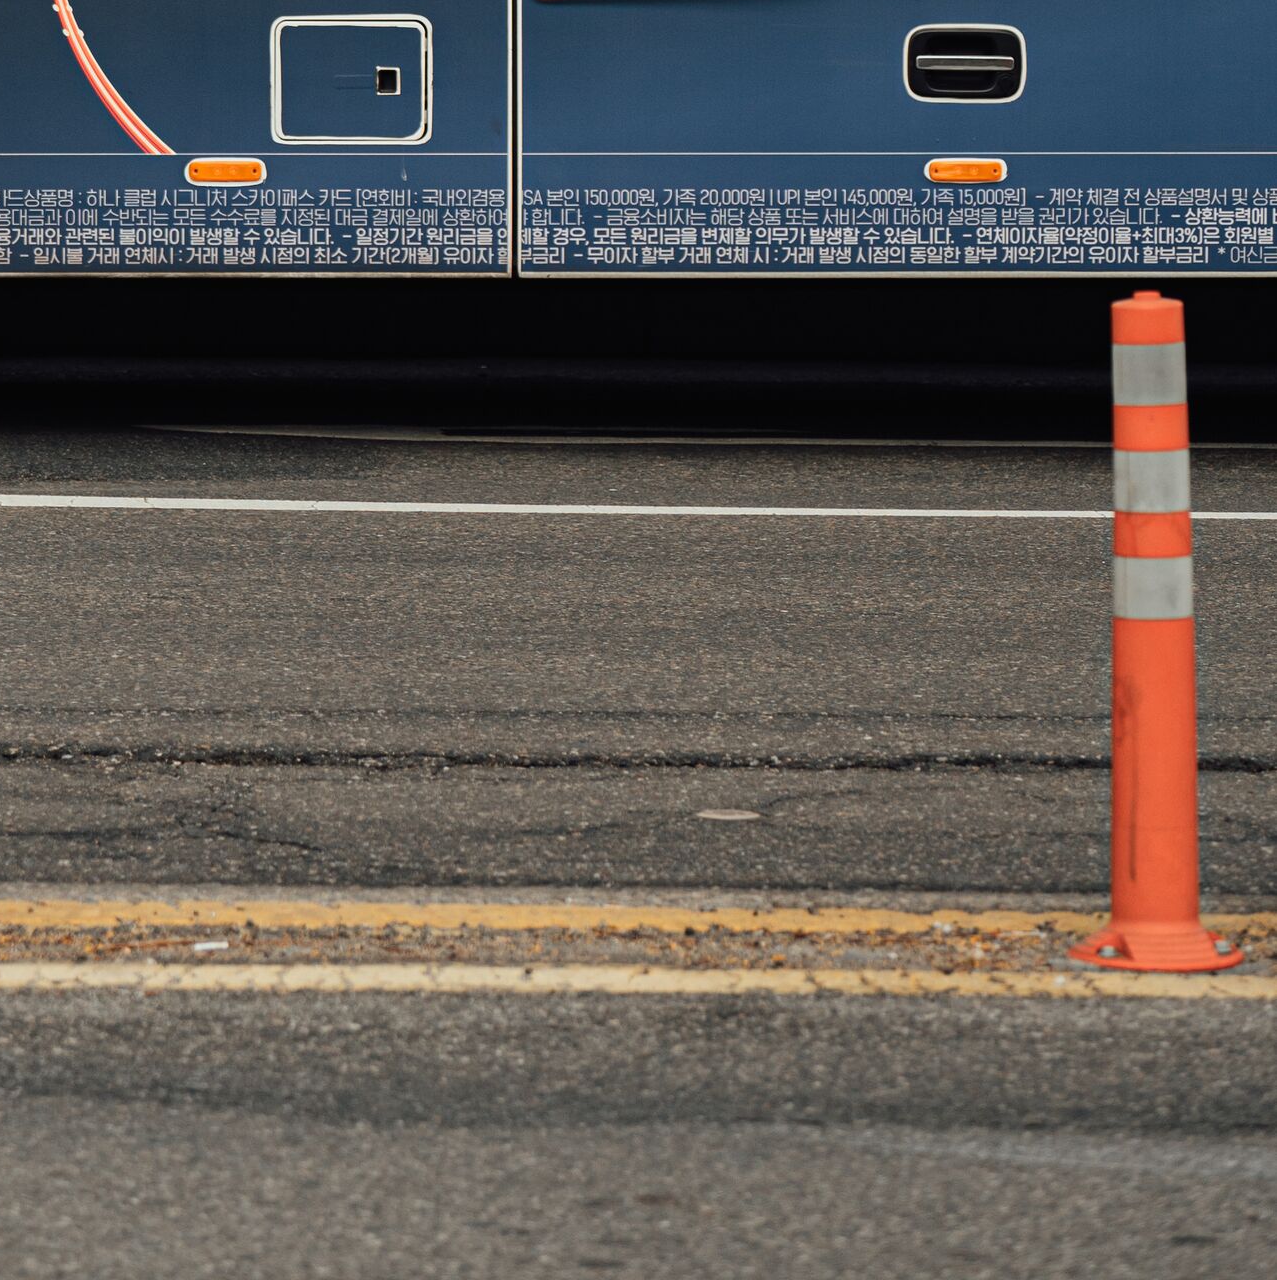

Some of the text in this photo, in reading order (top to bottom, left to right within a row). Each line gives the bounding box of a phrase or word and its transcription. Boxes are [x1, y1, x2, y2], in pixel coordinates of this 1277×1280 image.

[87, 189, 120, 207] 하나
[124, 189, 157, 207] 클럽
[161, 189, 227, 207] 시그니처
[231, 189, 315, 207] 스카이패스
[319, 189, 352, 207] 카드
[356, 189, 410, 207] [연회비
[422, 189, 505, 207] 국내외겸용
[547, 189, 579, 207] 본인
[584, 189, 658, 208] 150,000원,
[663, 188, 696, 206] 가족
[699, 188, 765, 206] 20,000원
[805, 188, 837, 206] 본인
[841, 188, 917, 207] 145,000원,
[921, 188, 955, 206] 가족
[959, 188, 1025, 206] 15,000원]
[1049, 188, 1083, 206] 계약
[1087, 188, 1119, 206] 체결
[1123, 188, 1139, 206] 전
[1144, 188, 1227, 206] 상품설명서
[1232, 188, 1247, 206] 및
[66, 209, 97, 226] 이에
[103, 209, 169, 226] 수반되는
[173, 209, 207, 226] 모든
[211, 209, 277, 226] 수수료를
[281, 209, 330, 226] 지정된
[335, 209, 369, 226] 대금
[373, 209, 438, 226] 결제일에
[532, 209, 585, 226] 합니다.
[607, 209, 707, 226] 금융소비자는
[711, 208, 744, 225] 해당
[748, 208, 781, 225] 상품
[785, 208, 818, 225] 또는
[823, 208, 888, 225] 서비스에
[894, 208, 942, 225] 대하여
[948, 208, 997, 225] 설명을
[1001, 208, 1034, 225] 받을
[1039, 208, 1089, 225] 권리가
[1093, 208, 1162, 225] 있습니다.
[1185, 208, 1267, 225] 상환능력에
[65, 228, 114, 245] 관련된
[119, 228, 185, 245] 불이익이
[190, 228, 240, 245] 발생할
[243, 228, 260, 245] 수
[264, 228, 335, 245] 있습니다.
[356, 228, 423, 245] 일정기간
[427, 228, 493, 245] 원리금을
[553, 228, 589, 246] 경우,
[593, 228, 627, 245] 모든
[631, 227, 697, 244] 원리금을
[701, 227, 752, 244] 변제할
[755, 227, 805, 244] 의무가
[810, 227, 859, 244] 발생할
[863, 227, 880, 244] 수
[884, 227, 954, 244] 있습니다.
[1224, 227, 1273, 244] 회원별
[33, 247, 83, 265] 일시불
[87, 247, 119, 265] 거래
[185, 247, 218, 265] 거래
[223, 247, 255, 265] 발생
[261, 247, 309, 265] 시점의
[314, 247, 347, 265] 최소
[443, 247, 494, 265] 유이자
[587, 247, 637, 265] 무이자
[641, 246, 674, 264] 할부
[679, 246, 711, 264] 거래
[716, 246, 749, 264] 연체
[753, 246, 769, 264] 시
[782, 246, 813, 264] 거래
[819, 246, 851, 264] 발생
[856, 246, 905, 264] 시점의
[911, 246, 961, 264] 동일한
[964, 246, 997, 264] 할부
[1001, 246, 1083, 264] 계약기간의
[1089, 246, 1139, 264] 유이자
[1143, 246, 1208, 264] 할부금리
